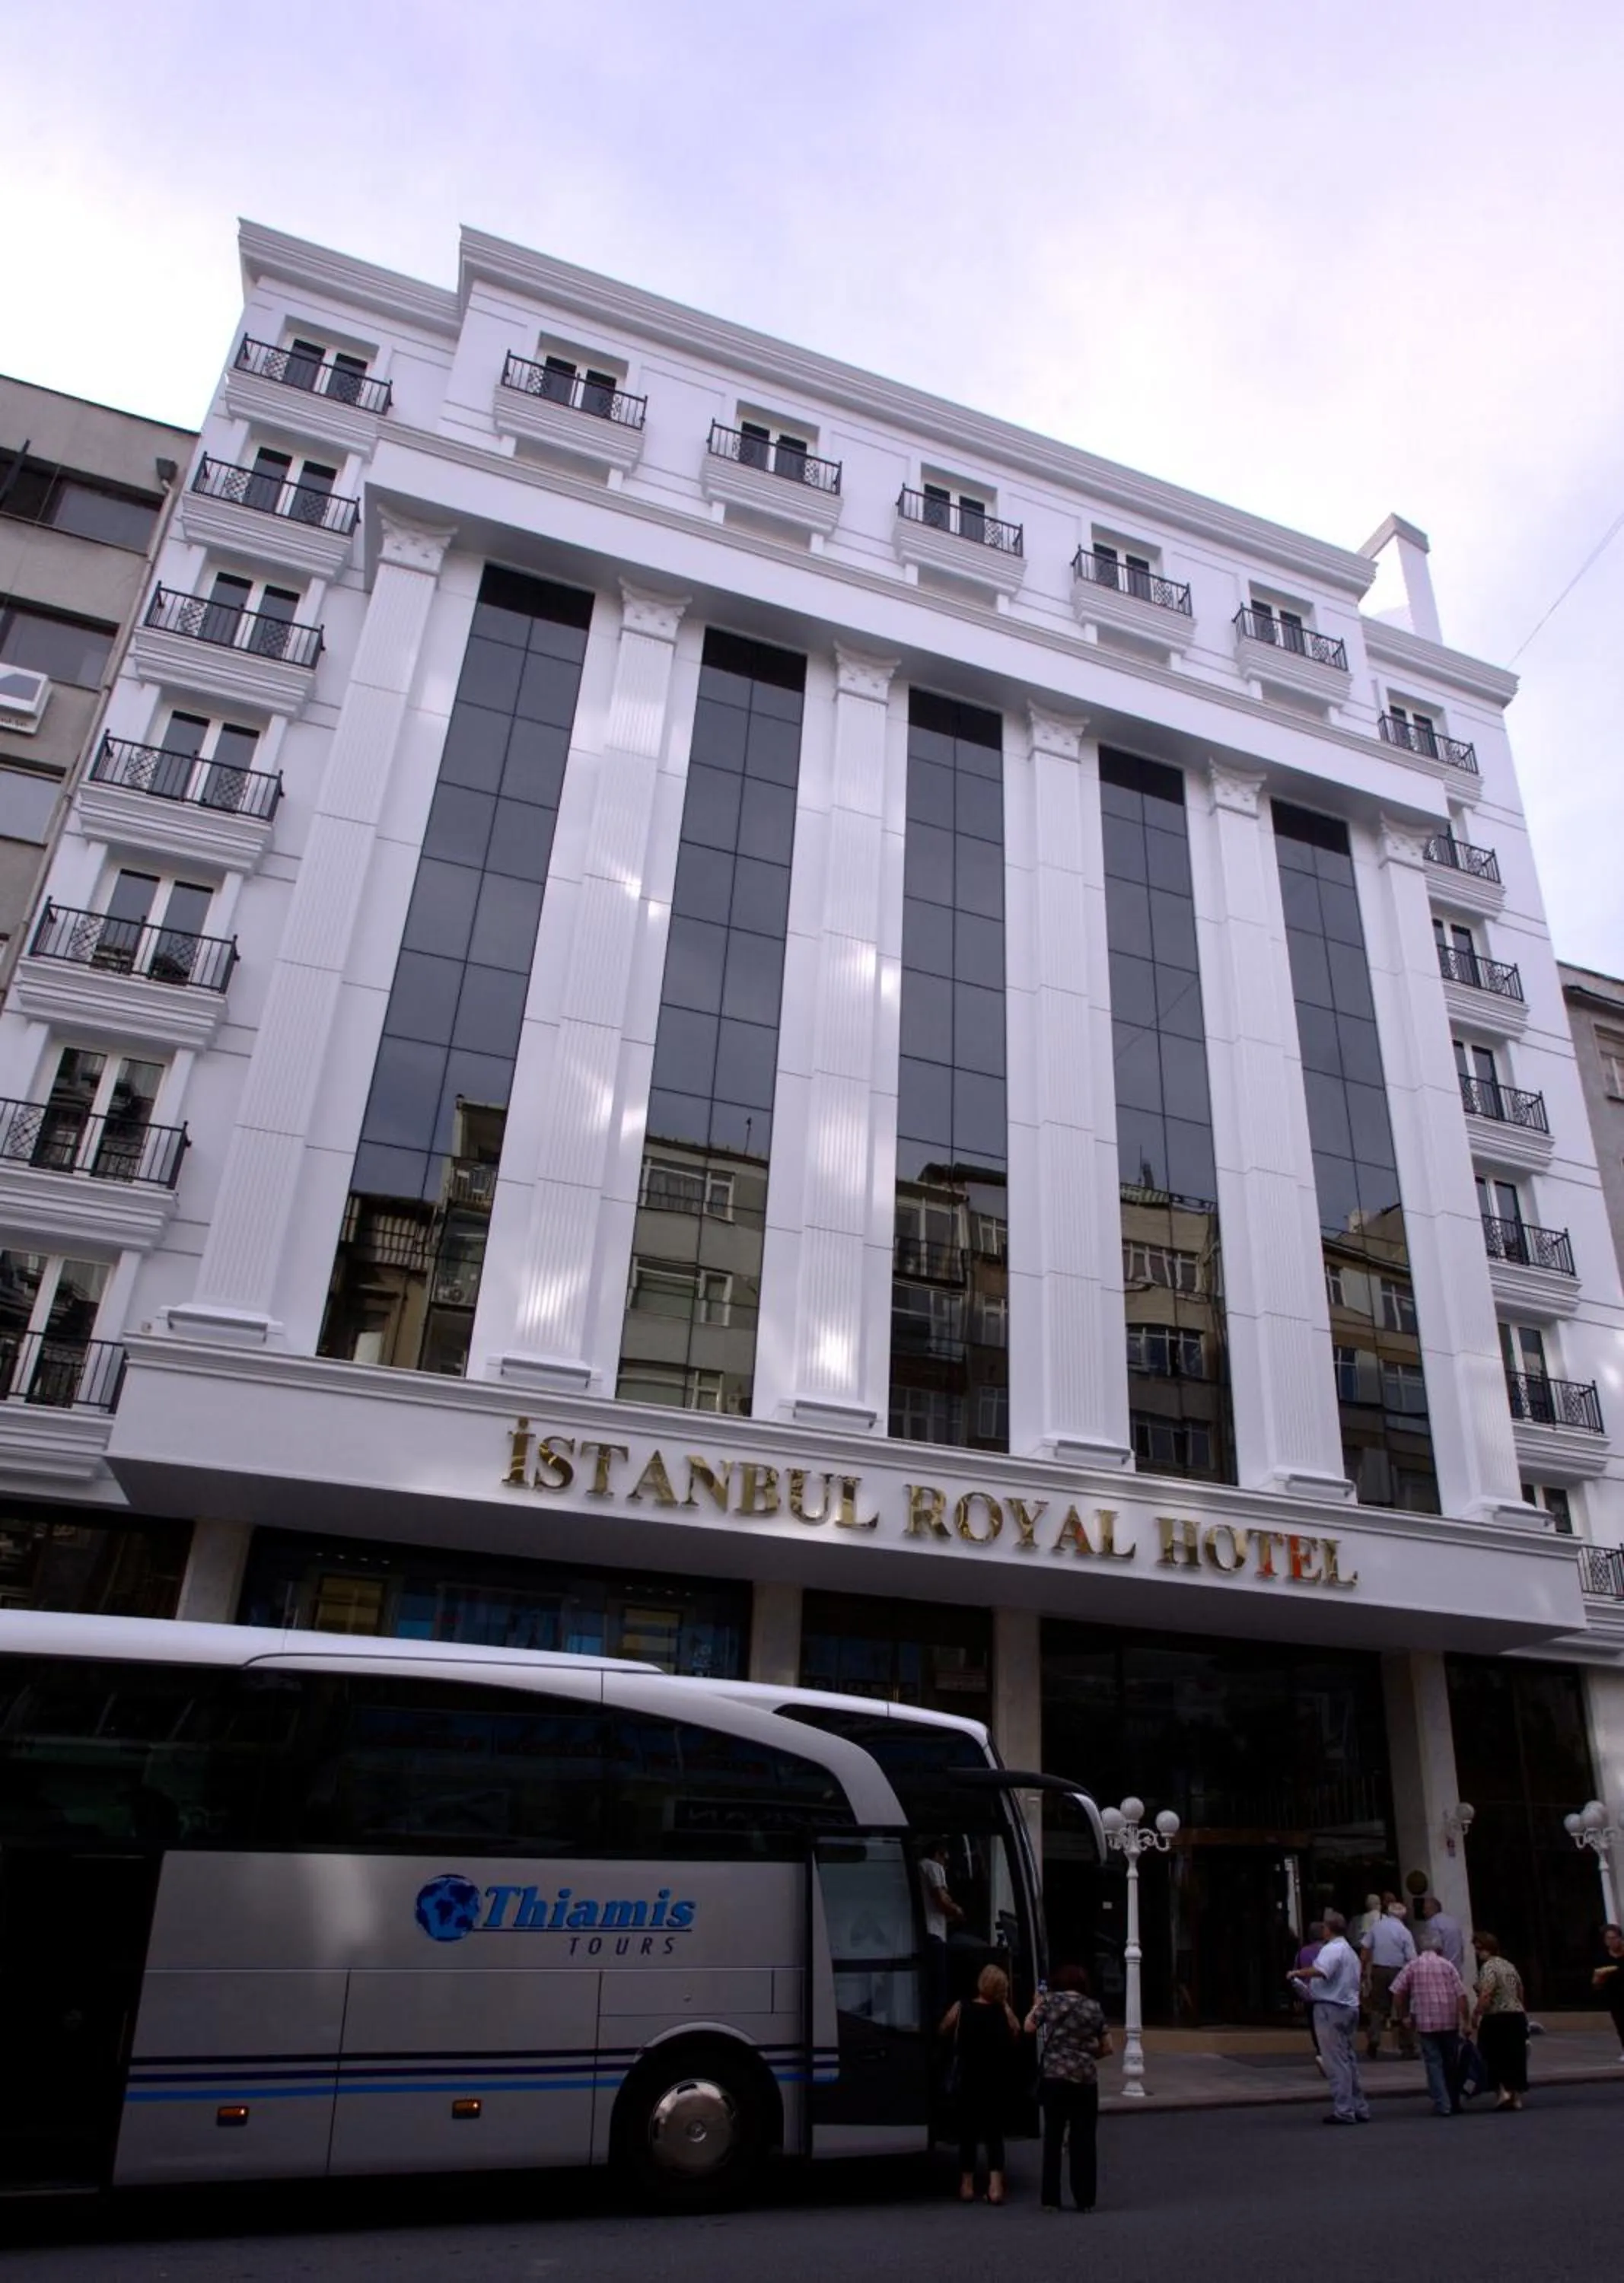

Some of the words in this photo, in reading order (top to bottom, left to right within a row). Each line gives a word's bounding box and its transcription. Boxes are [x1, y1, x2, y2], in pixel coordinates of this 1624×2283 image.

[903, 1484, 1136, 1559] ROYAL
[1155, 1517, 1359, 1587] HOTEL
[482, 1885, 696, 1928] Thiamis
[569, 1937, 678, 1957] TOURS
